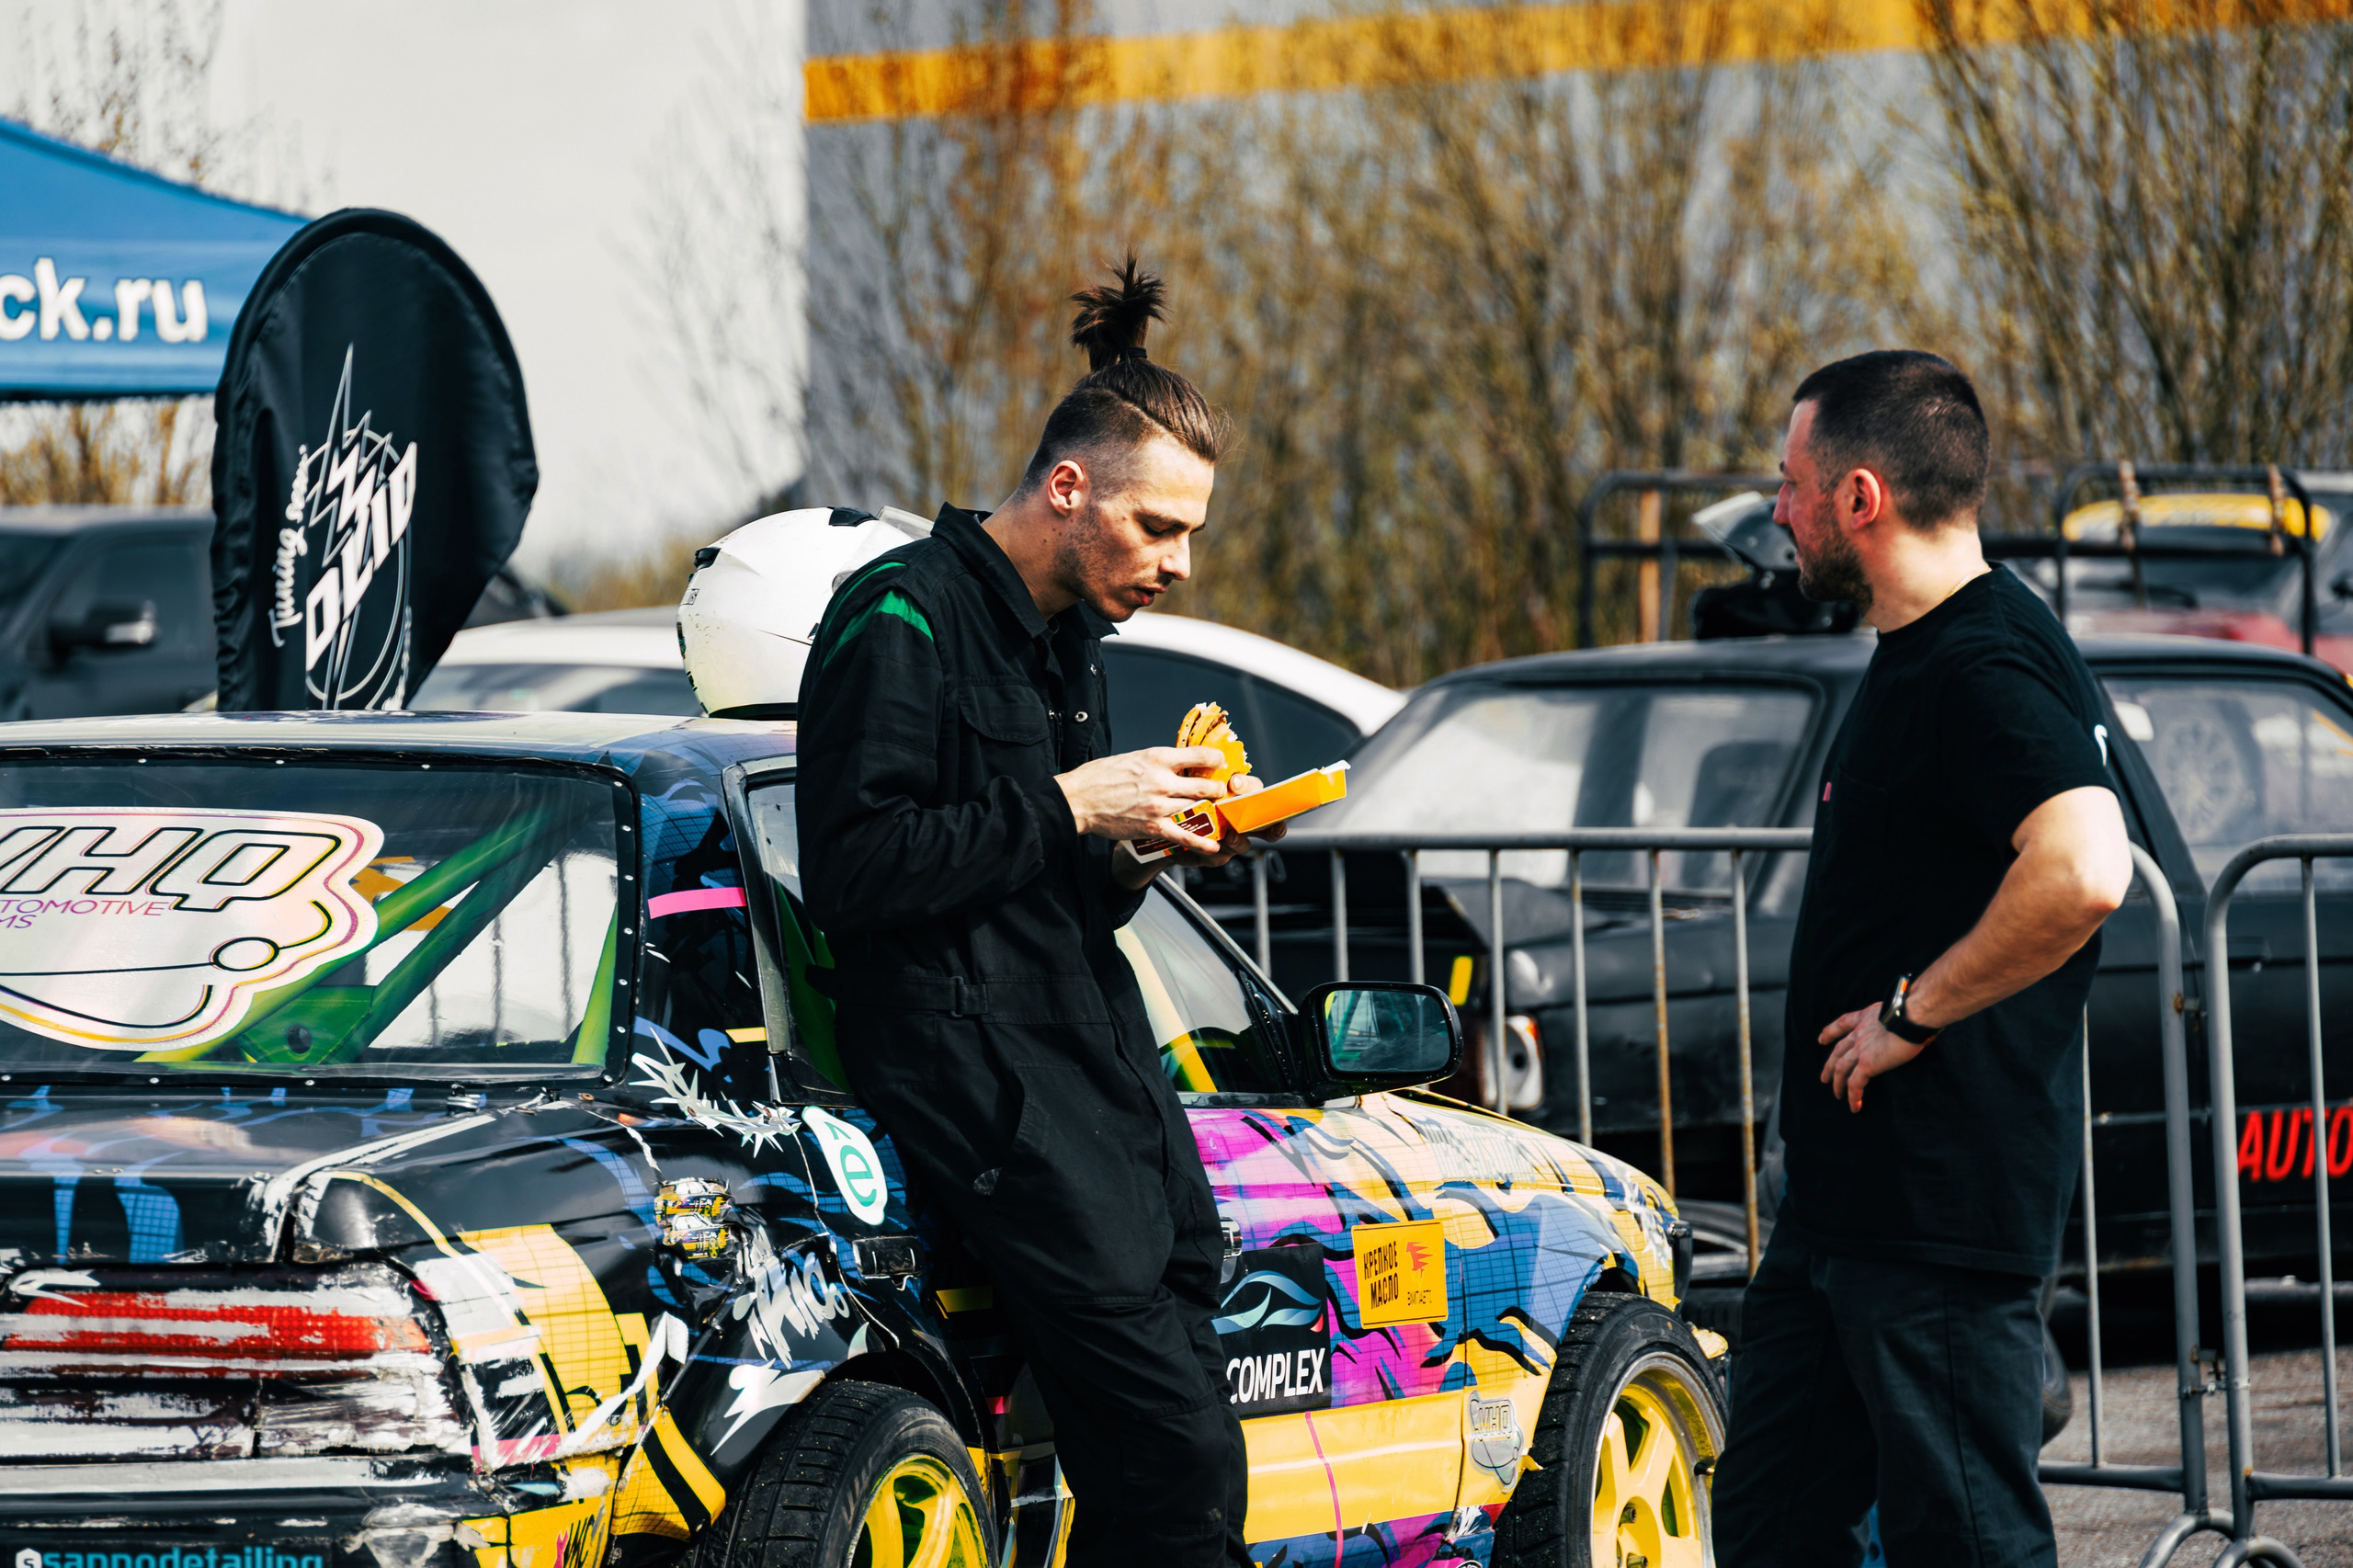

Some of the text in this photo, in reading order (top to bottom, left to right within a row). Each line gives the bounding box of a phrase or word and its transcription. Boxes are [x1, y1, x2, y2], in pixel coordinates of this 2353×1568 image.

[0, 257, 208, 343] ck.ru
[1363, 1241, 1398, 1280] КРЕПКОЕ
[1370, 1272, 1399, 1310] МАСЛО
[1226, 1347, 1325, 1404] COMPLEX
